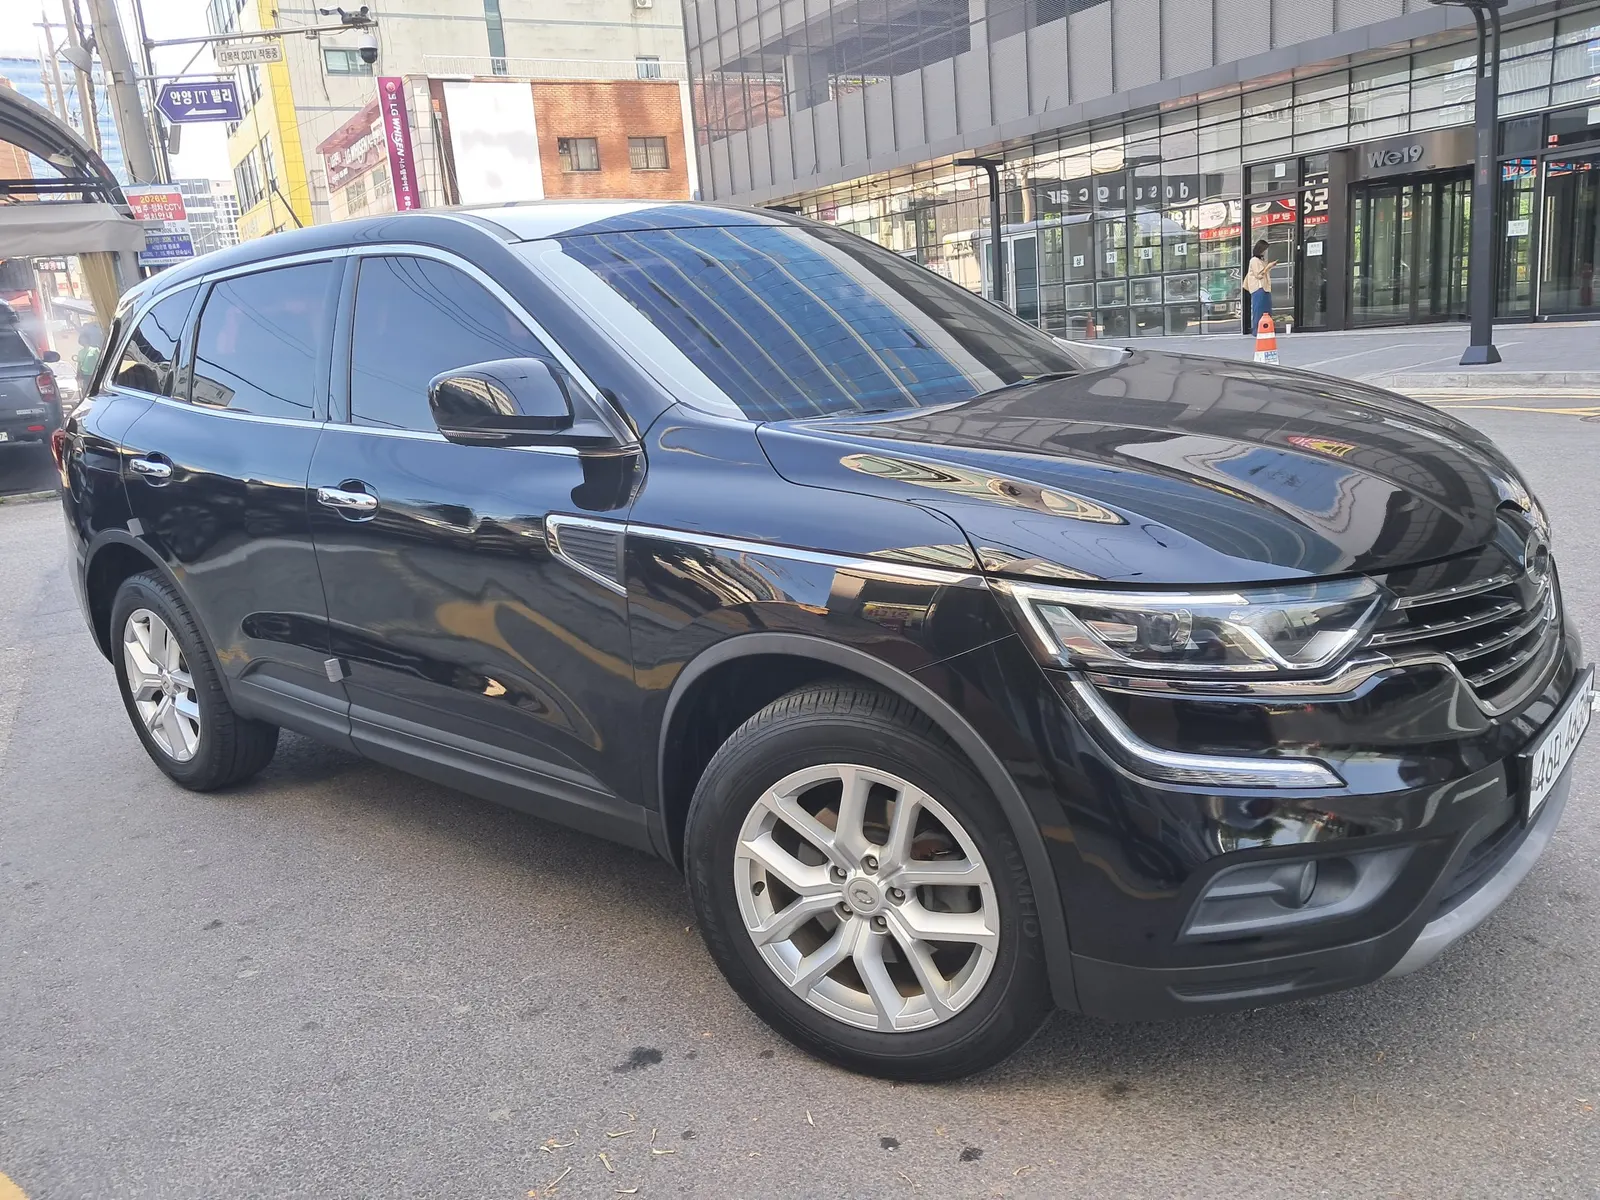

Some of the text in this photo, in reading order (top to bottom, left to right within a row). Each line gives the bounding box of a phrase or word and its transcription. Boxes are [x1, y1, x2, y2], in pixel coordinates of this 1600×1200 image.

[220, 47, 278, 62] 다목적 CCTV 작동중
[210, 88, 233, 103] 밸리
[390, 103, 399, 116] LG
[391, 117, 405, 156] WHISEN
[1367, 144, 1424, 169] We19
[140, 194, 168, 204] 2026년
[164, 203, 182, 211] CCTV
